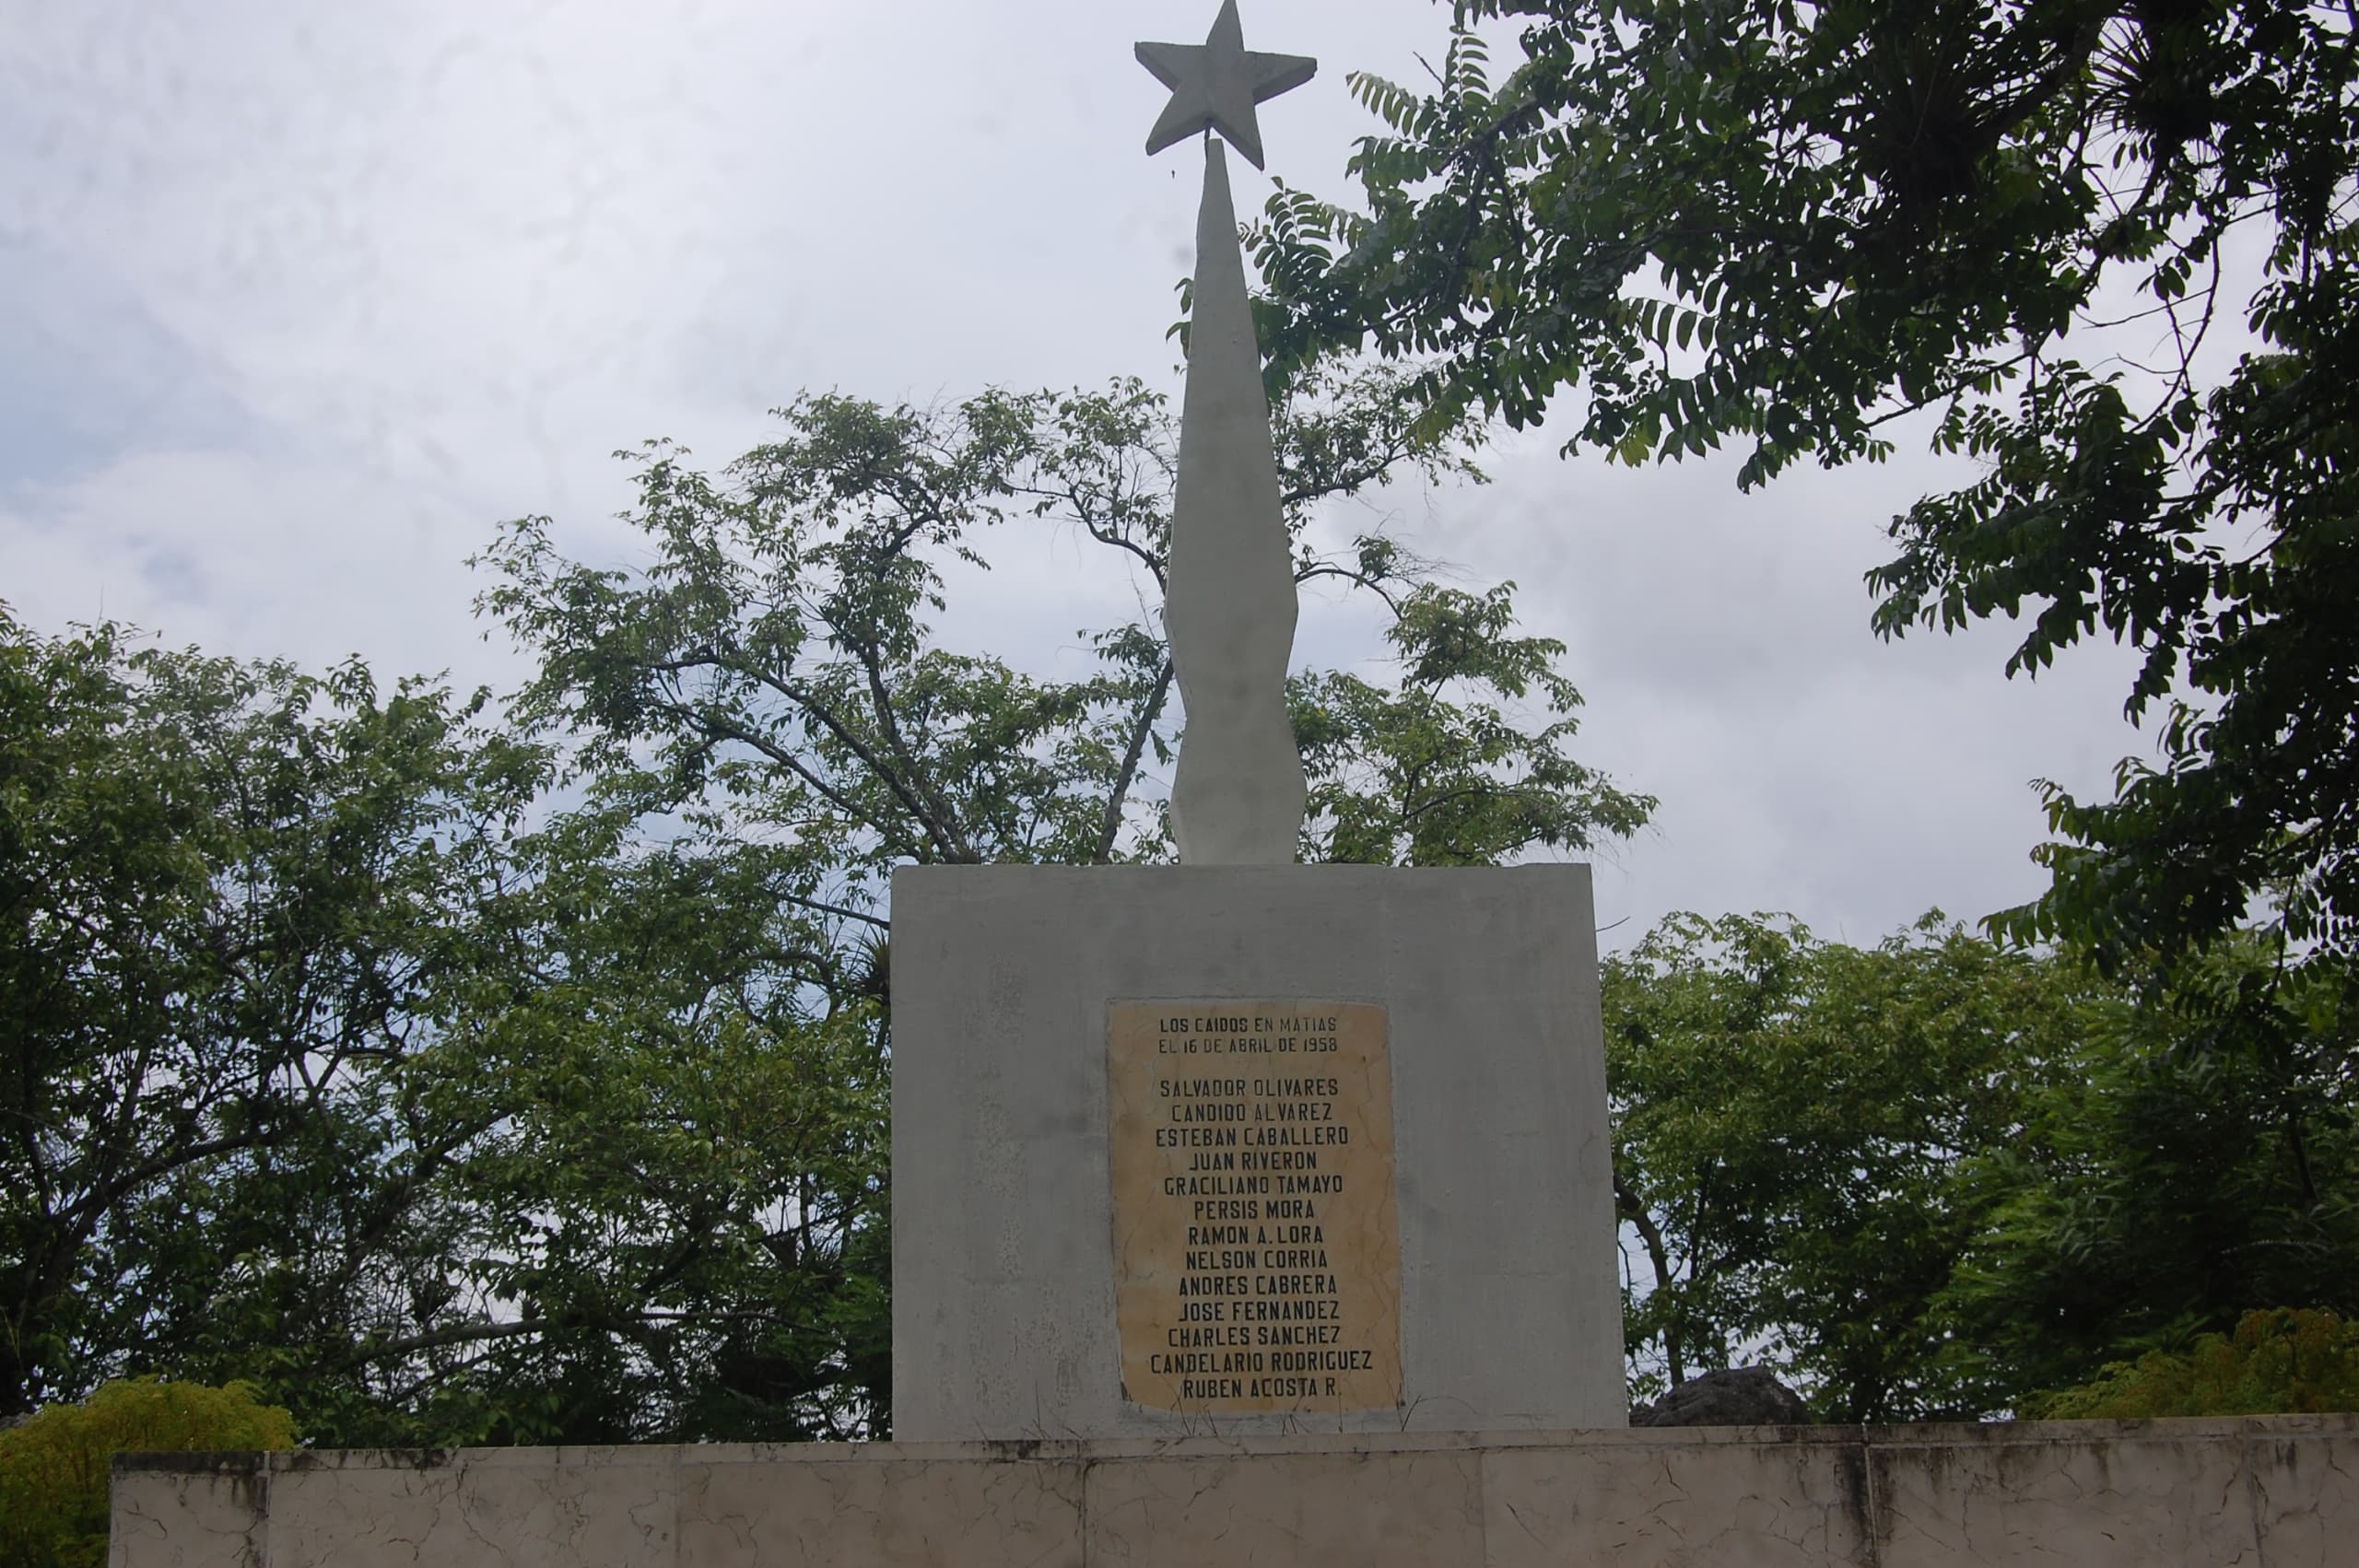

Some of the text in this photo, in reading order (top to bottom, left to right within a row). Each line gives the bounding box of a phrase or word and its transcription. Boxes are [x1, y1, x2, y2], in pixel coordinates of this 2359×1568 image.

[1160, 1017, 1336, 1033] LOS CAIDOS EN MATIAS
[1159, 1038, 1337, 1054] EL 16 DE ABRIL DE 1958
[1160, 1079, 1338, 1097] SALVADOR OLIVARES
[1172, 1104, 1332, 1122] CANDIDO ALVAREZ
[1156, 1127, 1348, 1147] ESTEBAN CABALLERO
[1189, 1152, 1317, 1171] JUAN RIVERON
[1165, 1176, 1342, 1196] GRACILIANO TAMAYO
[1194, 1199, 1314, 1220] PERSIS MORA
[1189, 1225, 1322, 1246] RAMON A. LORA
[1187, 1250, 1327, 1270] NELSON CORRIA
[1180, 1275, 1336, 1296] ANDRES CABRERA
[1179, 1301, 1339, 1321] JOSE FERNANDEZ
[1168, 1326, 1340, 1348] CHARLES SANCHEZ
[1151, 1351, 1372, 1374] CANDELARIO RODRIGUEZ
[1184, 1379, 1242, 1398] RUBEN
[1250, 1378, 1318, 1397] ACOSTA
